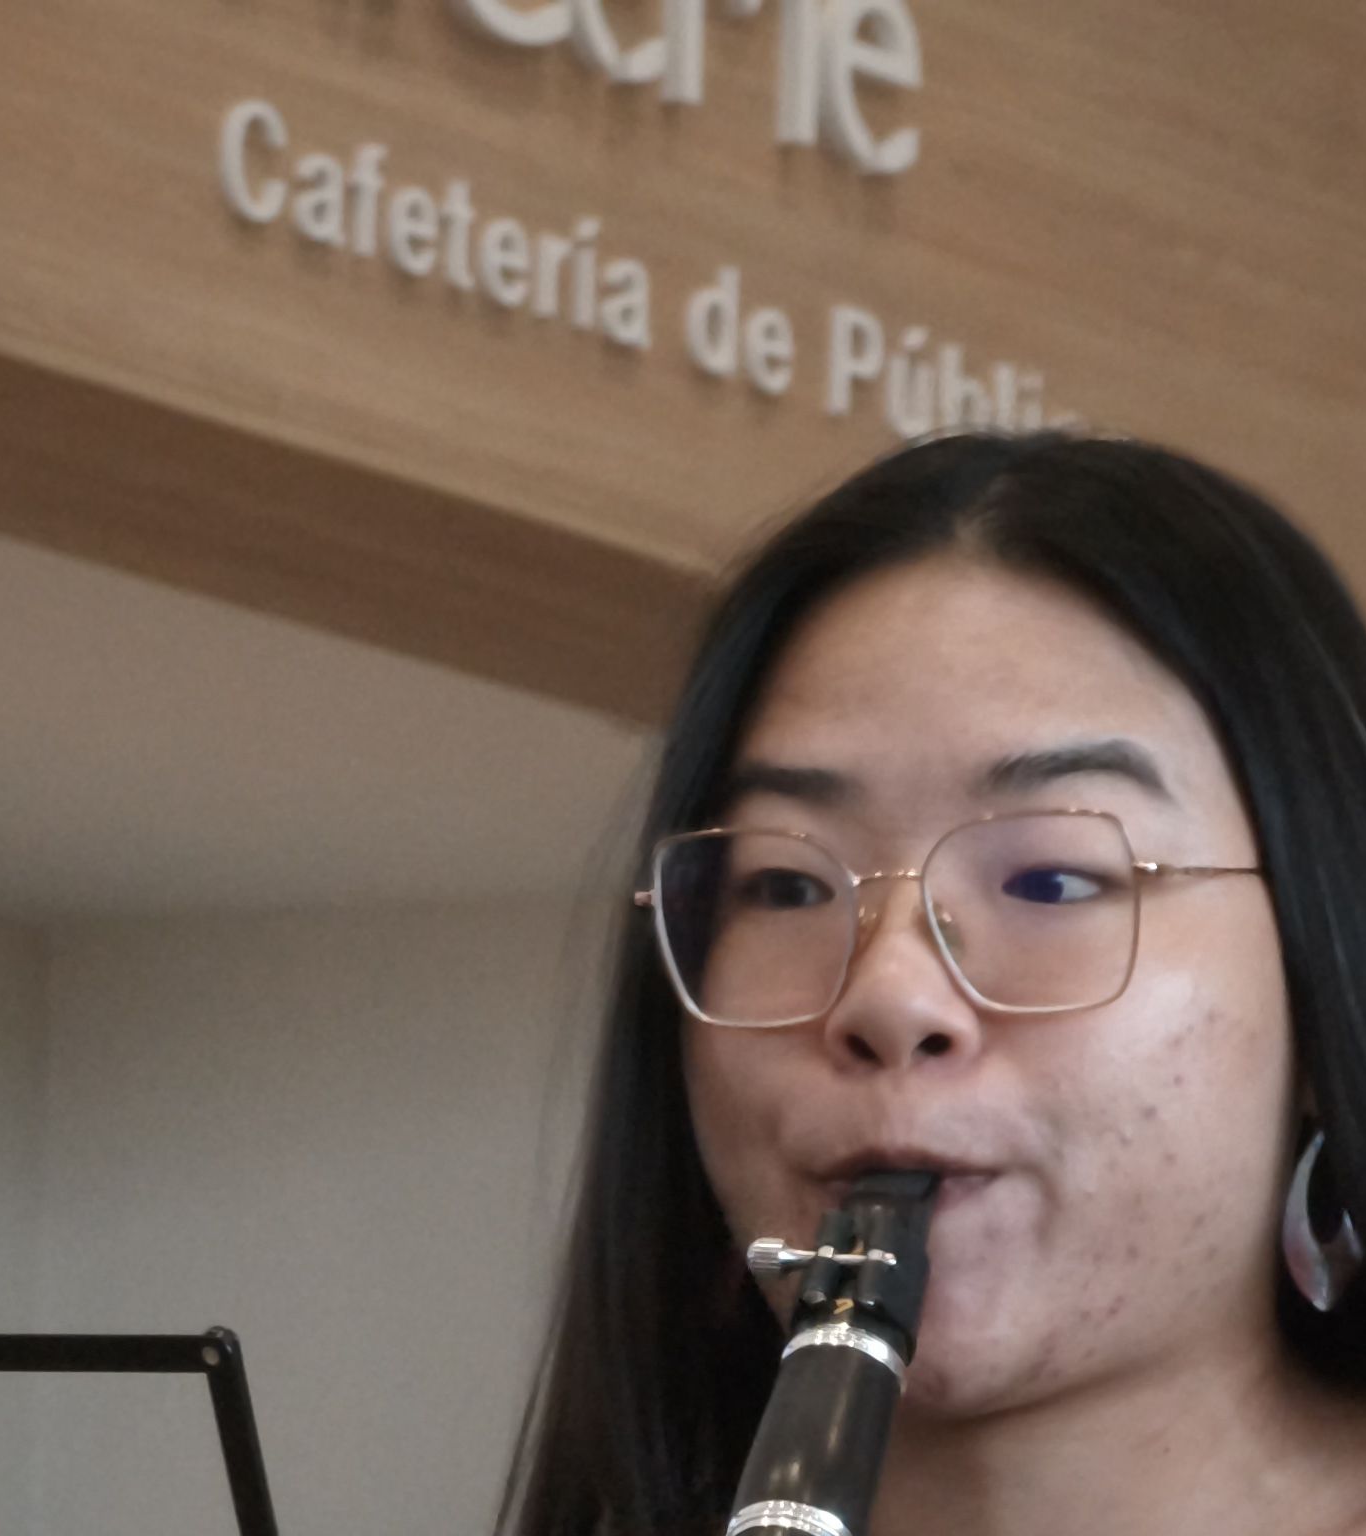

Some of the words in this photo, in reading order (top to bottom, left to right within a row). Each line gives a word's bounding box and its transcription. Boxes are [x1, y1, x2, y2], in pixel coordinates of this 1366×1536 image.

[220, 101, 652, 348] Cafetería
[686, 268, 796, 394] de
[827, 303, 1081, 440] Públi
